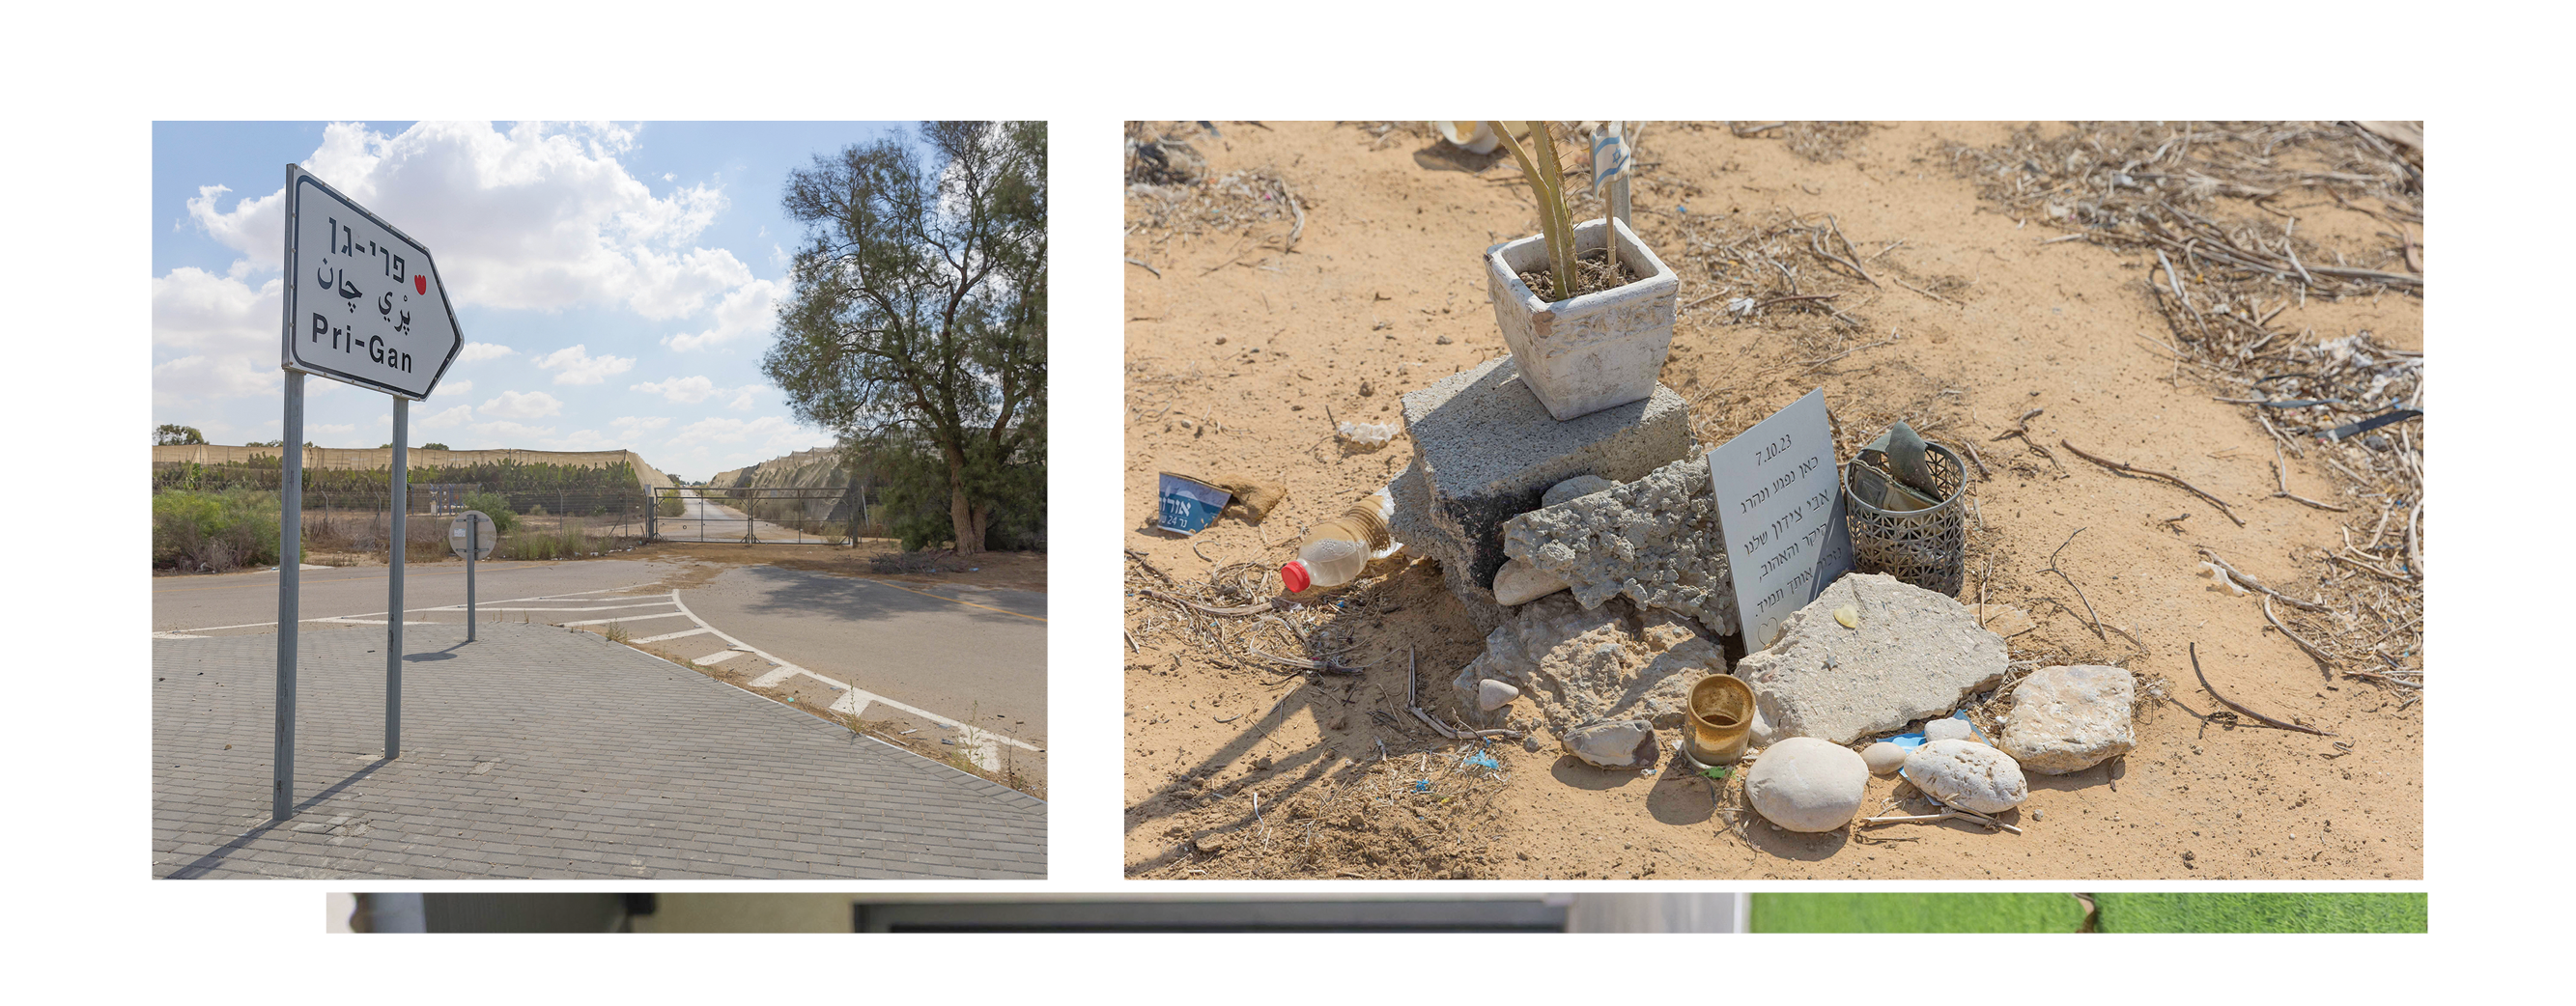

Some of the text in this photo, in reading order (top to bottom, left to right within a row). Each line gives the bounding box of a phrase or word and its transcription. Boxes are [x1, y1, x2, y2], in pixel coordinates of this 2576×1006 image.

[328, 216, 406, 284] פרי-גן
[312, 312, 412, 374] Pri-Gan
[1755, 433, 1792, 466] 7.10.23
[1741, 456, 1819, 515] כאן נפגע ונהרג
[1167, 515, 1177, 526] 24
[1178, 517, 1188, 528] נר
[1744, 489, 1829, 556] אבי צידון שלנו
[1758, 522, 1827, 583] היקר והאהוב,
[1755, 588, 1785, 618] תמיד.
[1786, 567, 1813, 595] אותך
